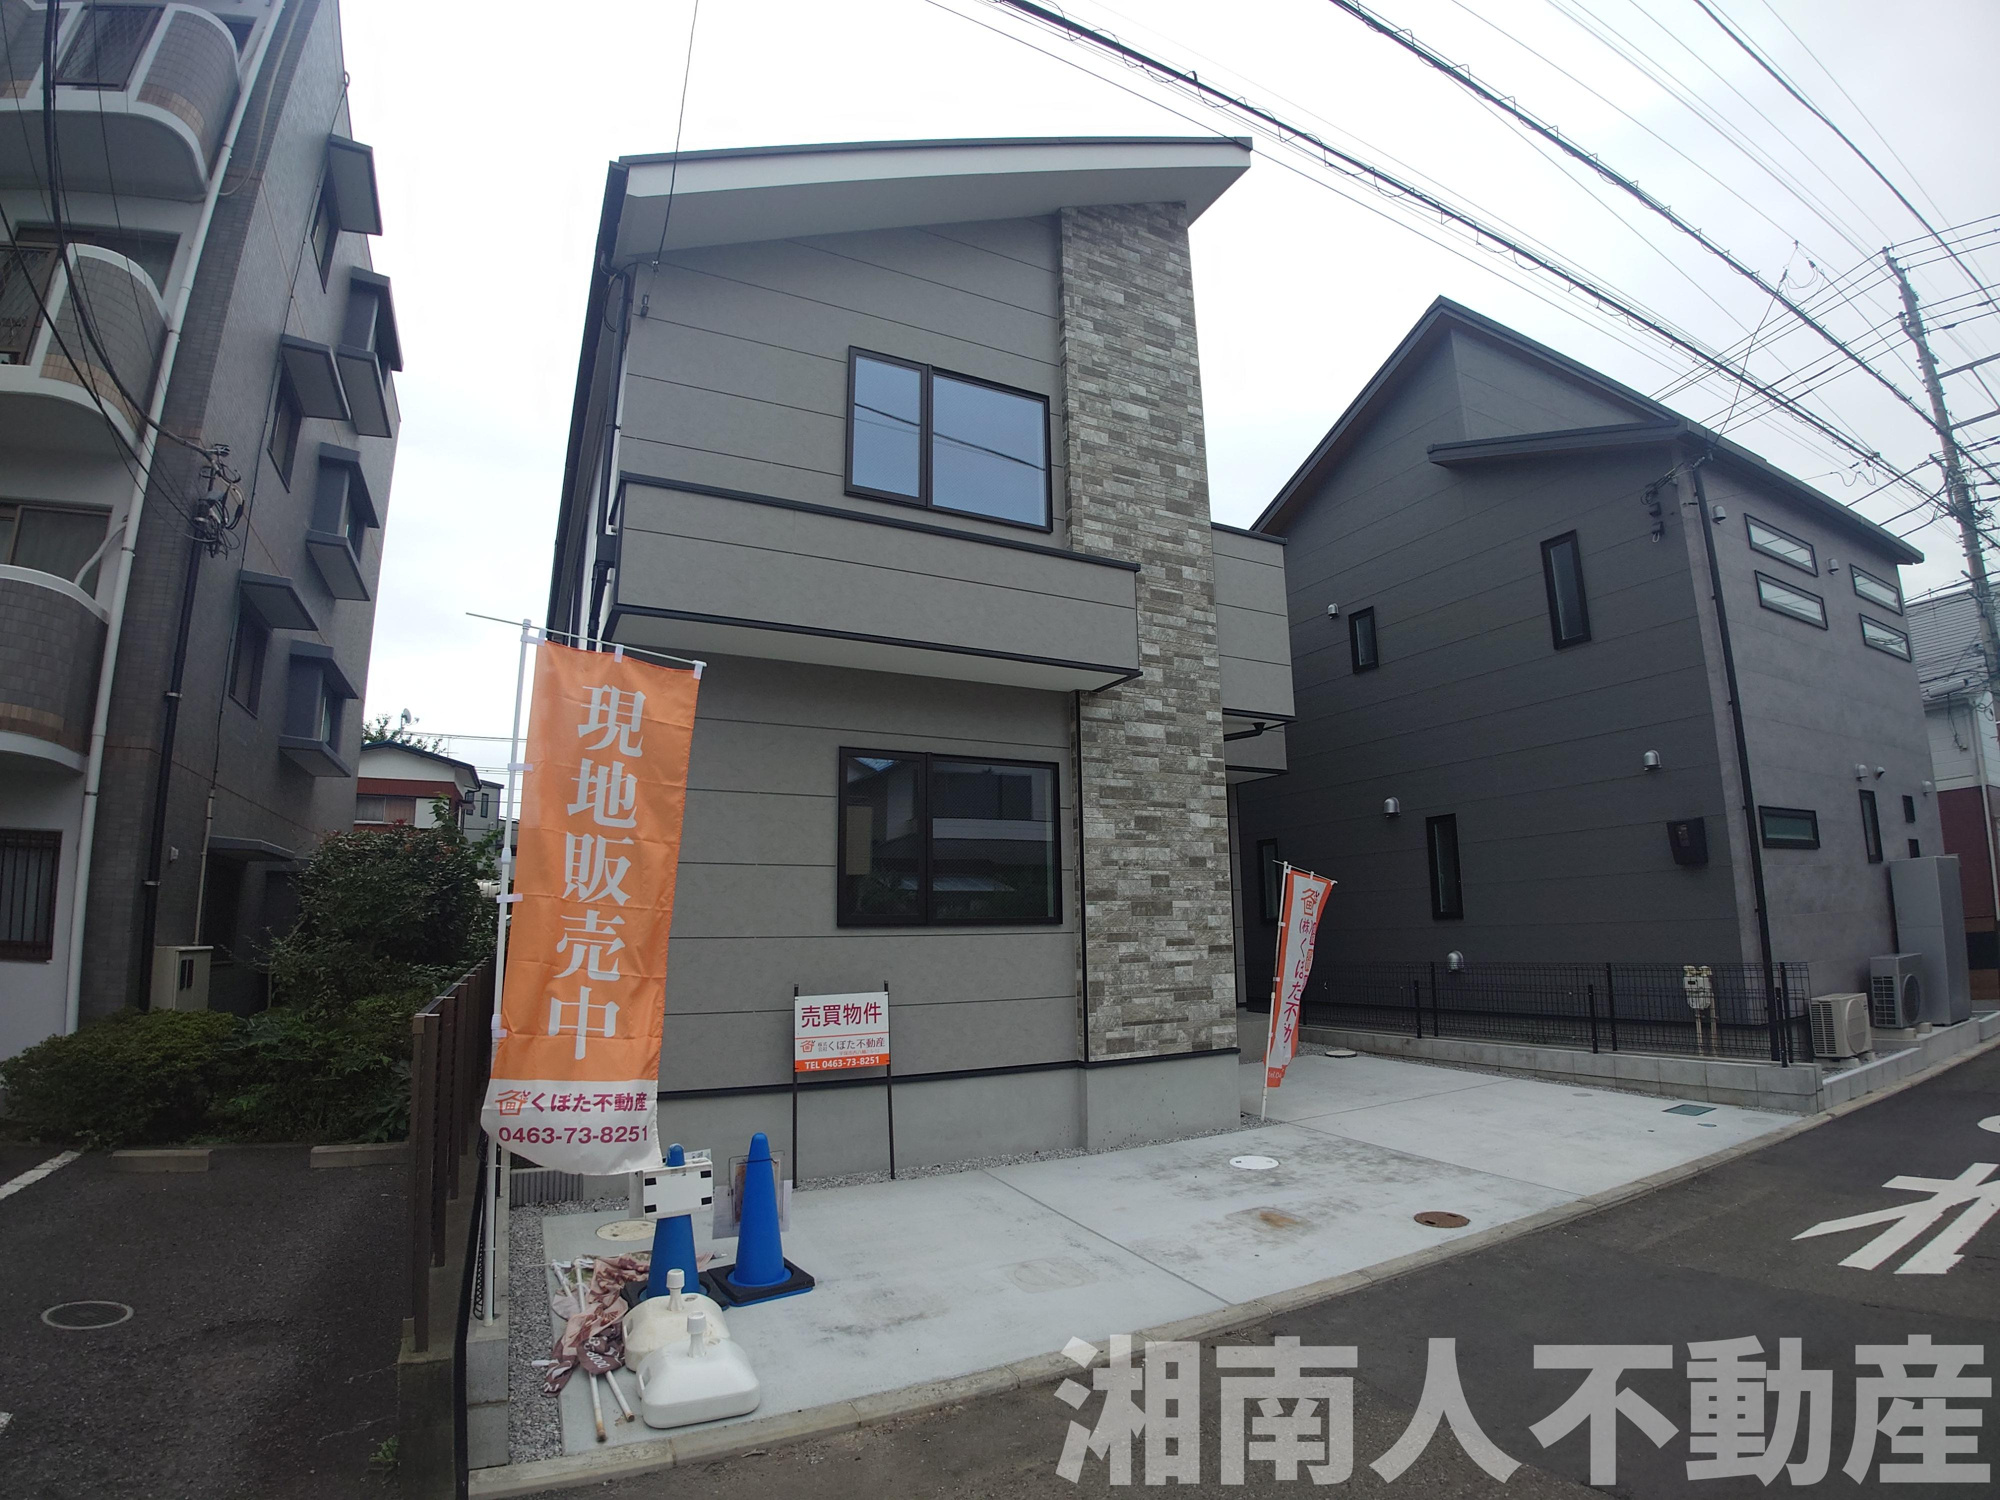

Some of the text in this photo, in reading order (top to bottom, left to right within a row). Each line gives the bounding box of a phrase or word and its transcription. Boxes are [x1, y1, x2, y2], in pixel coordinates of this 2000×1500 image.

[548, 683, 646, 1061] 現地販売中
[801, 1001, 882, 1028] 売買物件
[828, 1036, 886, 1051] くぼた不動産
[805, 1056, 880, 1070] TEL 0463-73-8251
[531, 1092, 648, 1113] くぼた不動産
[498, 1125, 648, 1144] 0463-73-8251
